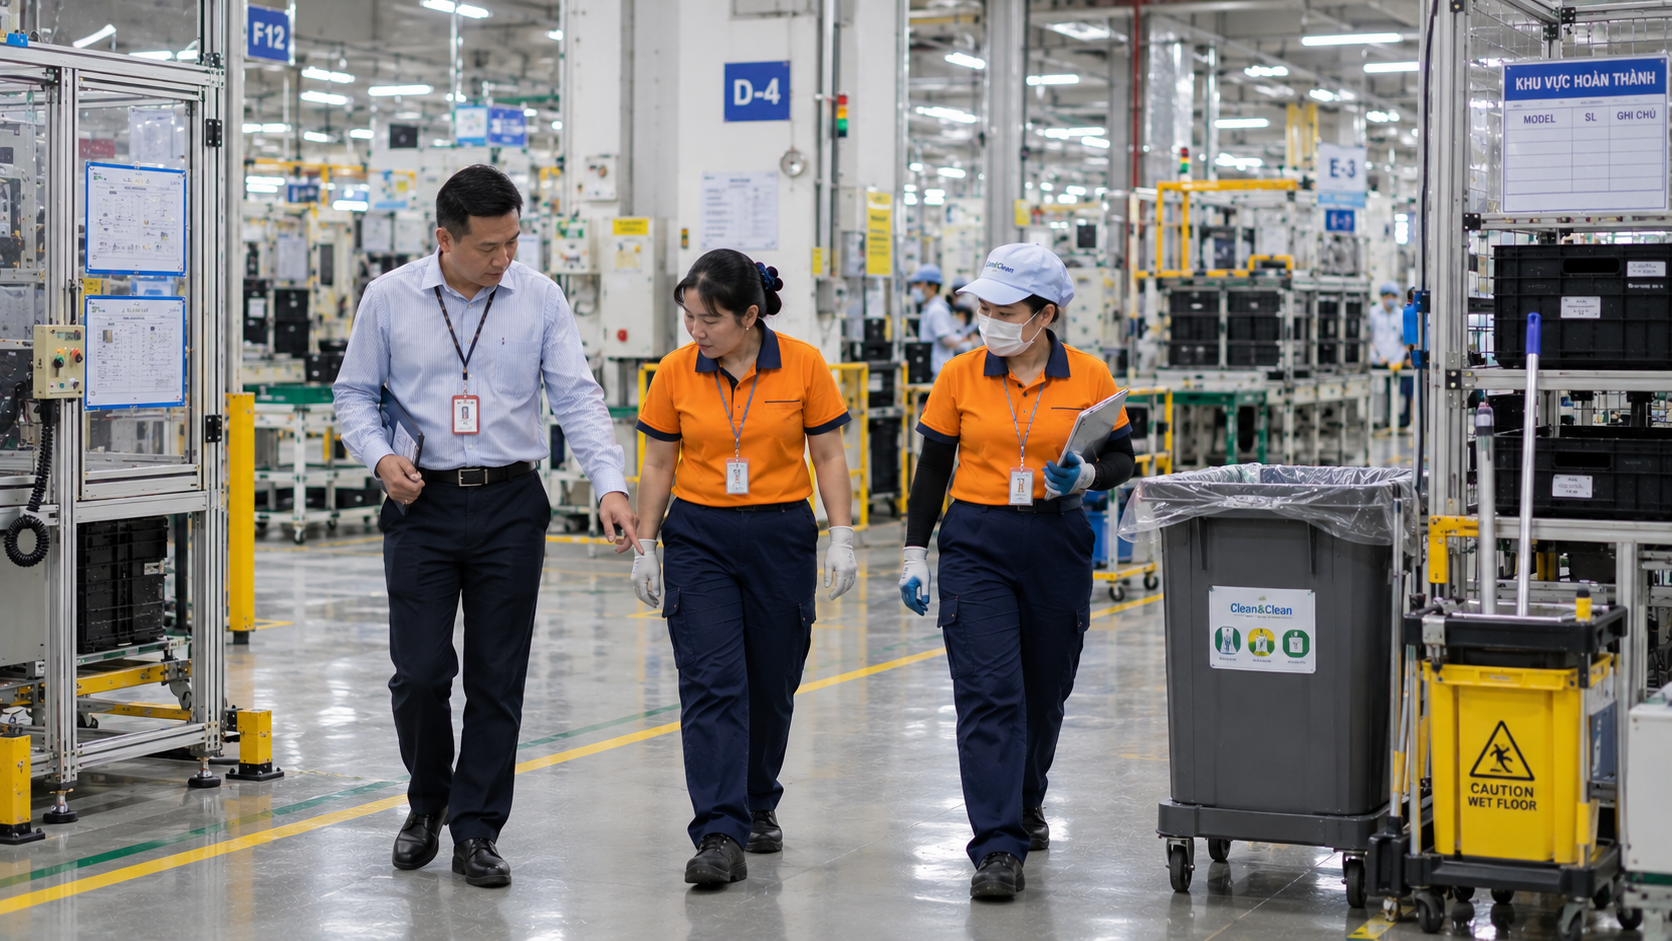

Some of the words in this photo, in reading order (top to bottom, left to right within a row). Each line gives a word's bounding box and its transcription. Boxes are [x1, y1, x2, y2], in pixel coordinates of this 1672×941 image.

[253, 21, 286, 50] F12
[1515, 77, 1541, 91] KHU
[1545, 74, 1571, 92] VỰC
[1574, 70, 1609, 88] HOÀN
[1612, 68, 1656, 86] THÀNH
[733, 77, 781, 106] D-4
[1523, 114, 1556, 124] MODEL
[1584, 112, 1597, 122] SL
[1616, 111, 1634, 121] GHI
[1636, 108, 1656, 120] CHÚ
[1330, 157, 1356, 178] E-3
[1230, 602, 1293, 616] Clean&Clean
[1470, 782, 1534, 798] CAUTION
[1468, 796, 1493, 808] WET
[1497, 798, 1537, 811] FLOOR
